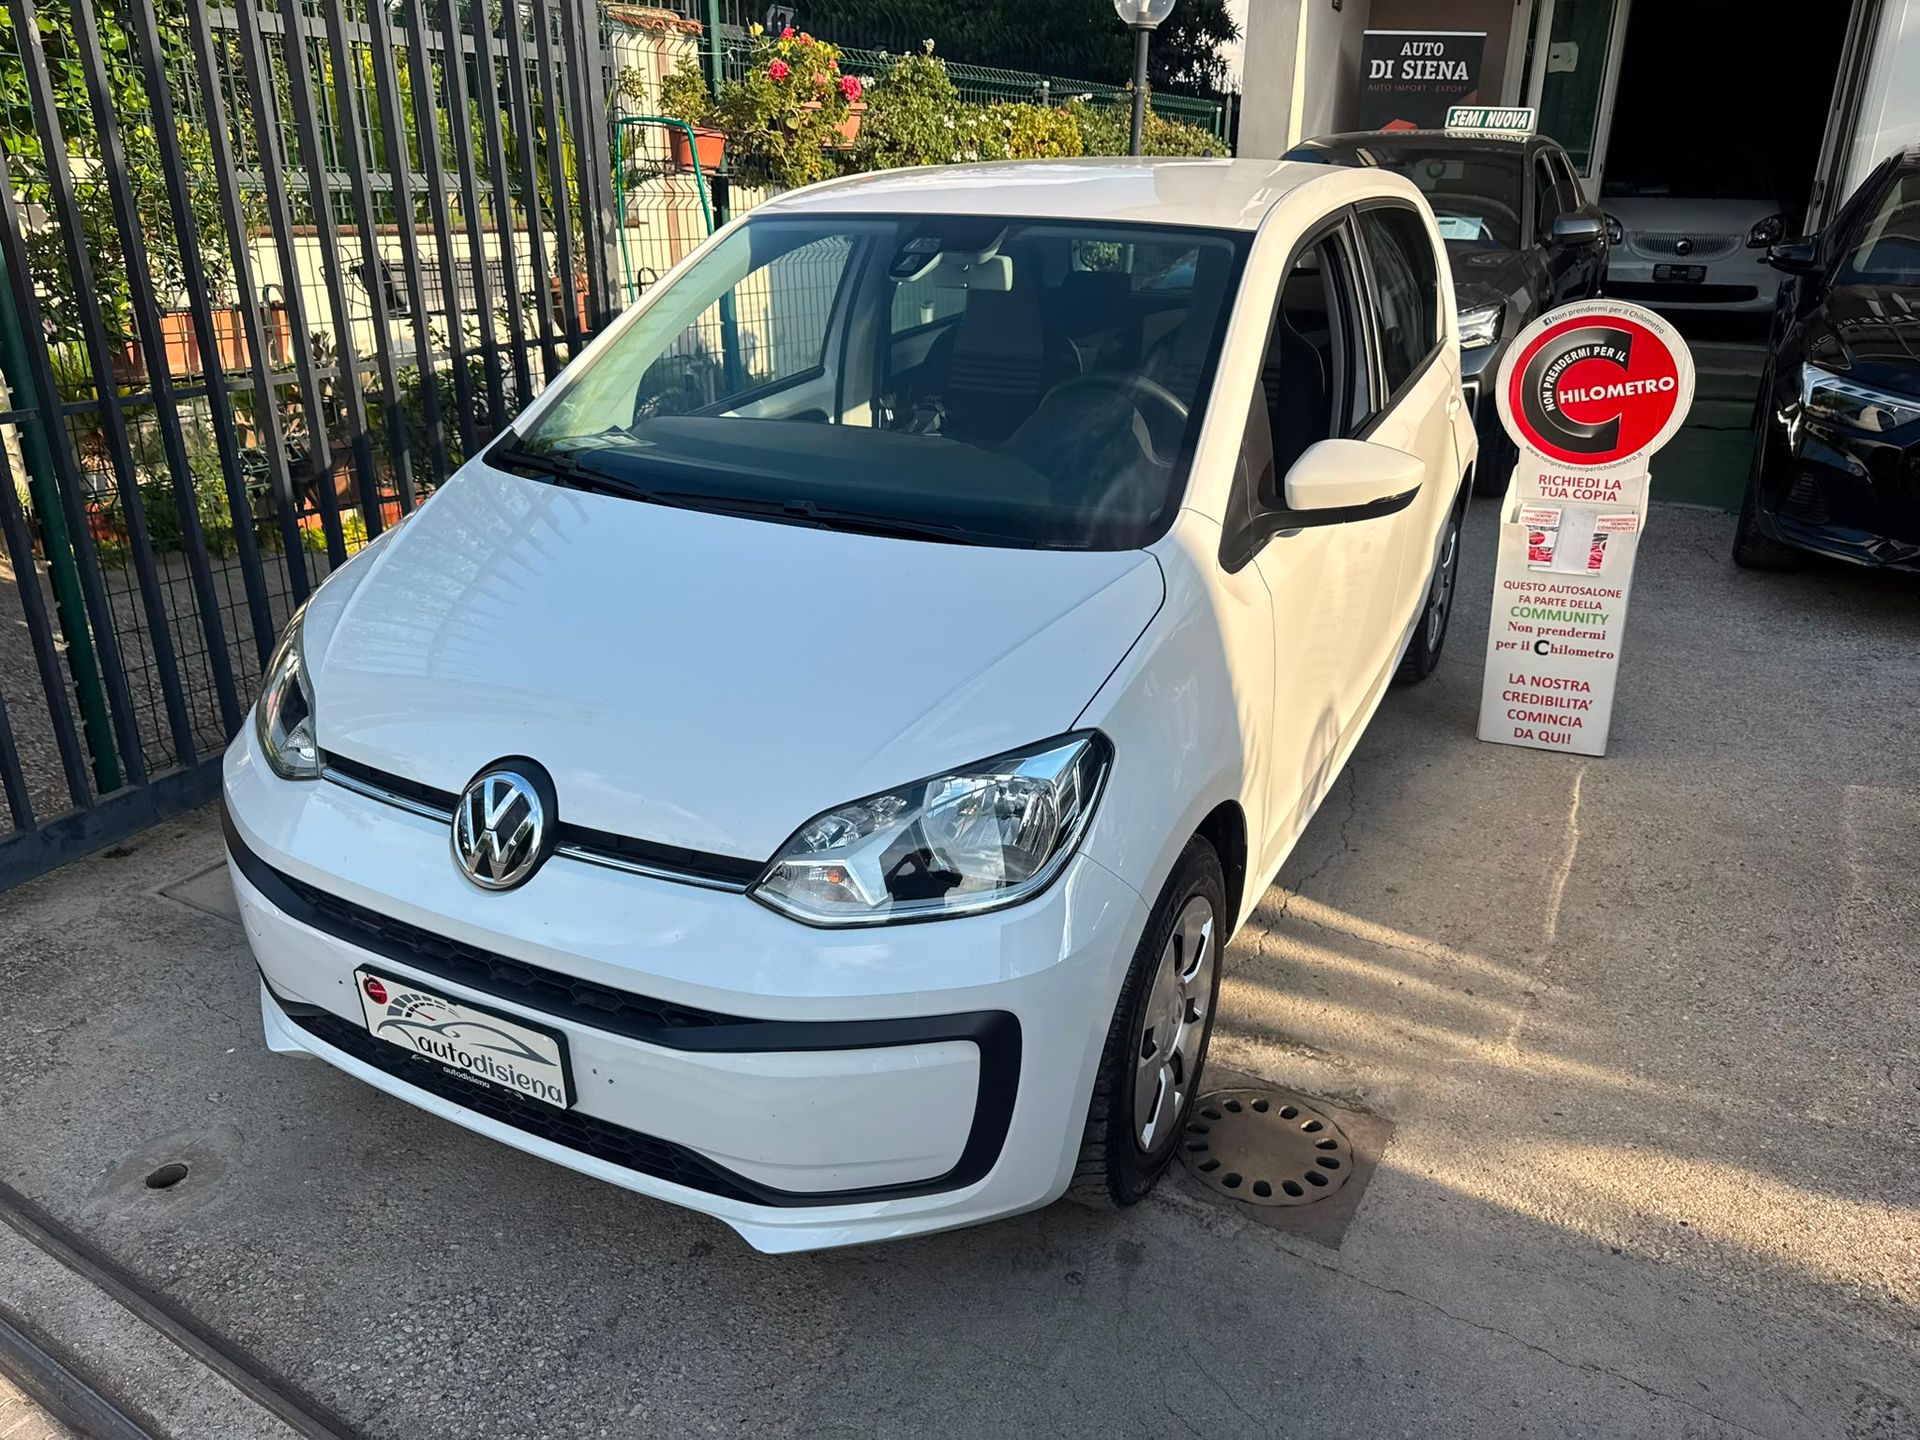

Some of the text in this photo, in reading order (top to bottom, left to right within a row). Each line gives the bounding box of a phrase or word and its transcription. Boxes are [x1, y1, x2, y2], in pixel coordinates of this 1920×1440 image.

[1400, 41, 1444, 57] AUTO
[1369, 59, 1469, 81] DI SIENA
[1367, 83, 1468, 94] AUTO IMPORT EXPORT
[1450, 110, 1529, 128] SEMI NUOVA
[1552, 313, 1567, 322] Non
[1568, 305, 1607, 317] prendermi
[1609, 306, 1622, 314] per
[1623, 307, 1628, 315] il
[1629, 310, 1665, 334] Chilometro
[1543, 346, 1626, 412] NON PRENDERMI PER IL
[1538, 474, 1622, 490] RICHIEDI LA
[1540, 486, 1617, 501] TUA COPIA
[1503, 580, 1622, 599] QUESTO AUTOSALONE
[1518, 595, 1602, 610] FA PARTE DELLA
[1510, 606, 1609, 625] COMMUNITY
[1507, 621, 1607, 640] Non prendermi
[1495, 639, 1615, 660] per il Chilometro
[1508, 673, 1590, 693] LA NOSTRA
[1507, 708, 1583, 728] COMINCIA
[1513, 727, 1571, 745] DA QUI!
[458, 774, 540, 885] VW
[417, 1036, 563, 1104] autodisiena
[443, 1066, 490, 1089] autodisiena
